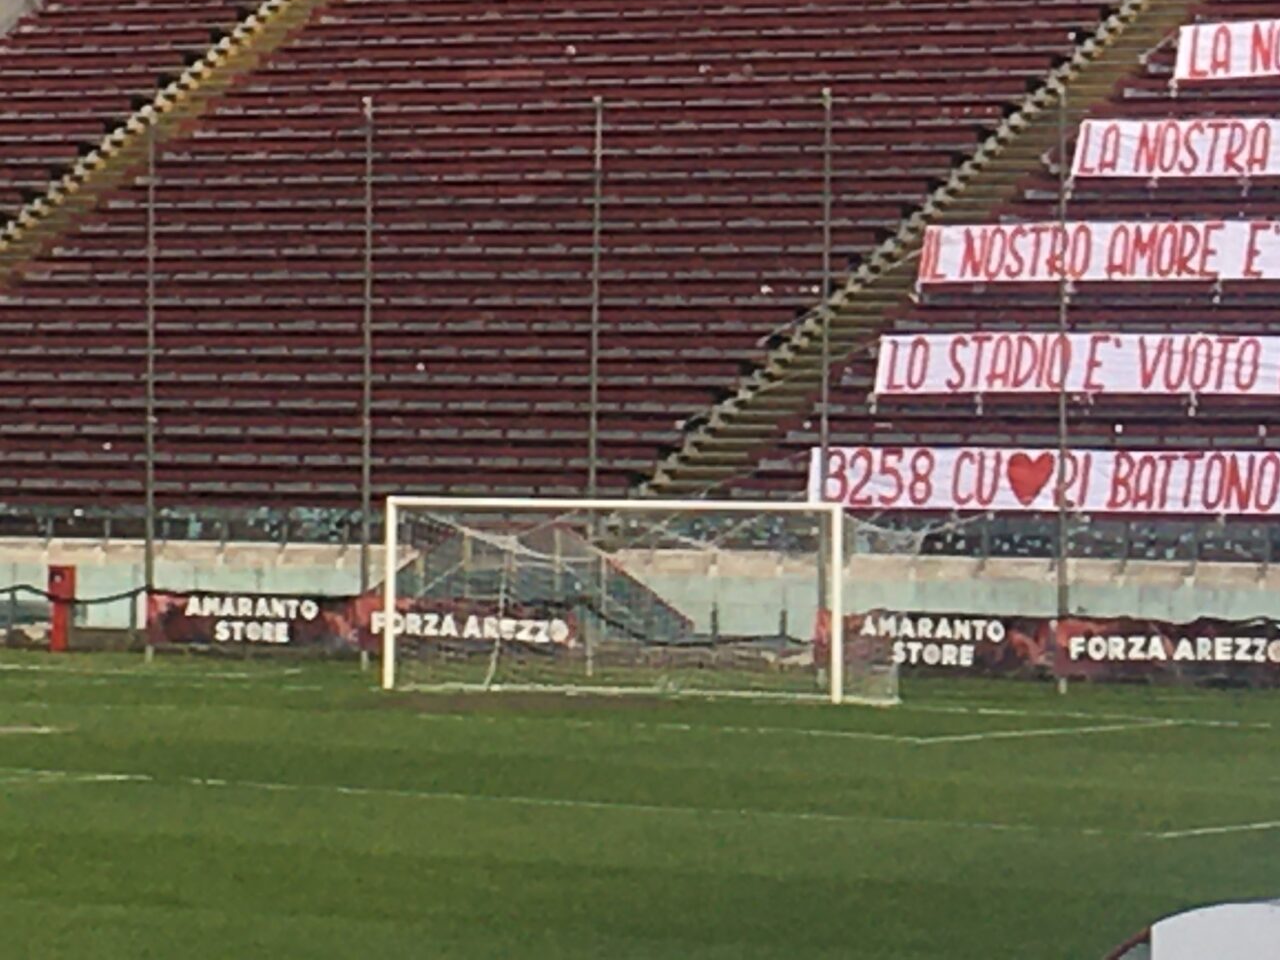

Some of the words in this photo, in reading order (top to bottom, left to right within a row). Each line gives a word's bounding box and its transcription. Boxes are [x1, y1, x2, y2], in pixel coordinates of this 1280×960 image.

[1187, 25, 1232, 77] LA
[1078, 123, 1120, 174] LA
[1134, 119, 1271, 173] NOSTRA
[919, 228, 946, 280] IL
[960, 224, 1092, 279] NOSTRO
[1105, 223, 1225, 278] AMORE
[886, 336, 929, 390] LO
[946, 334, 1072, 390] STADIO
[1138, 336, 1262, 392] VUOTO
[184, 596, 320, 621] AMARANTO
[215, 622, 290, 643] STORE
[370, 611, 458, 637] FORZA
[462, 614, 569, 643] AREZZO
[860, 614, 1005, 642] AMARANTO
[893, 640, 974, 667] STORE
[1070, 635, 1173, 662] FORZA
